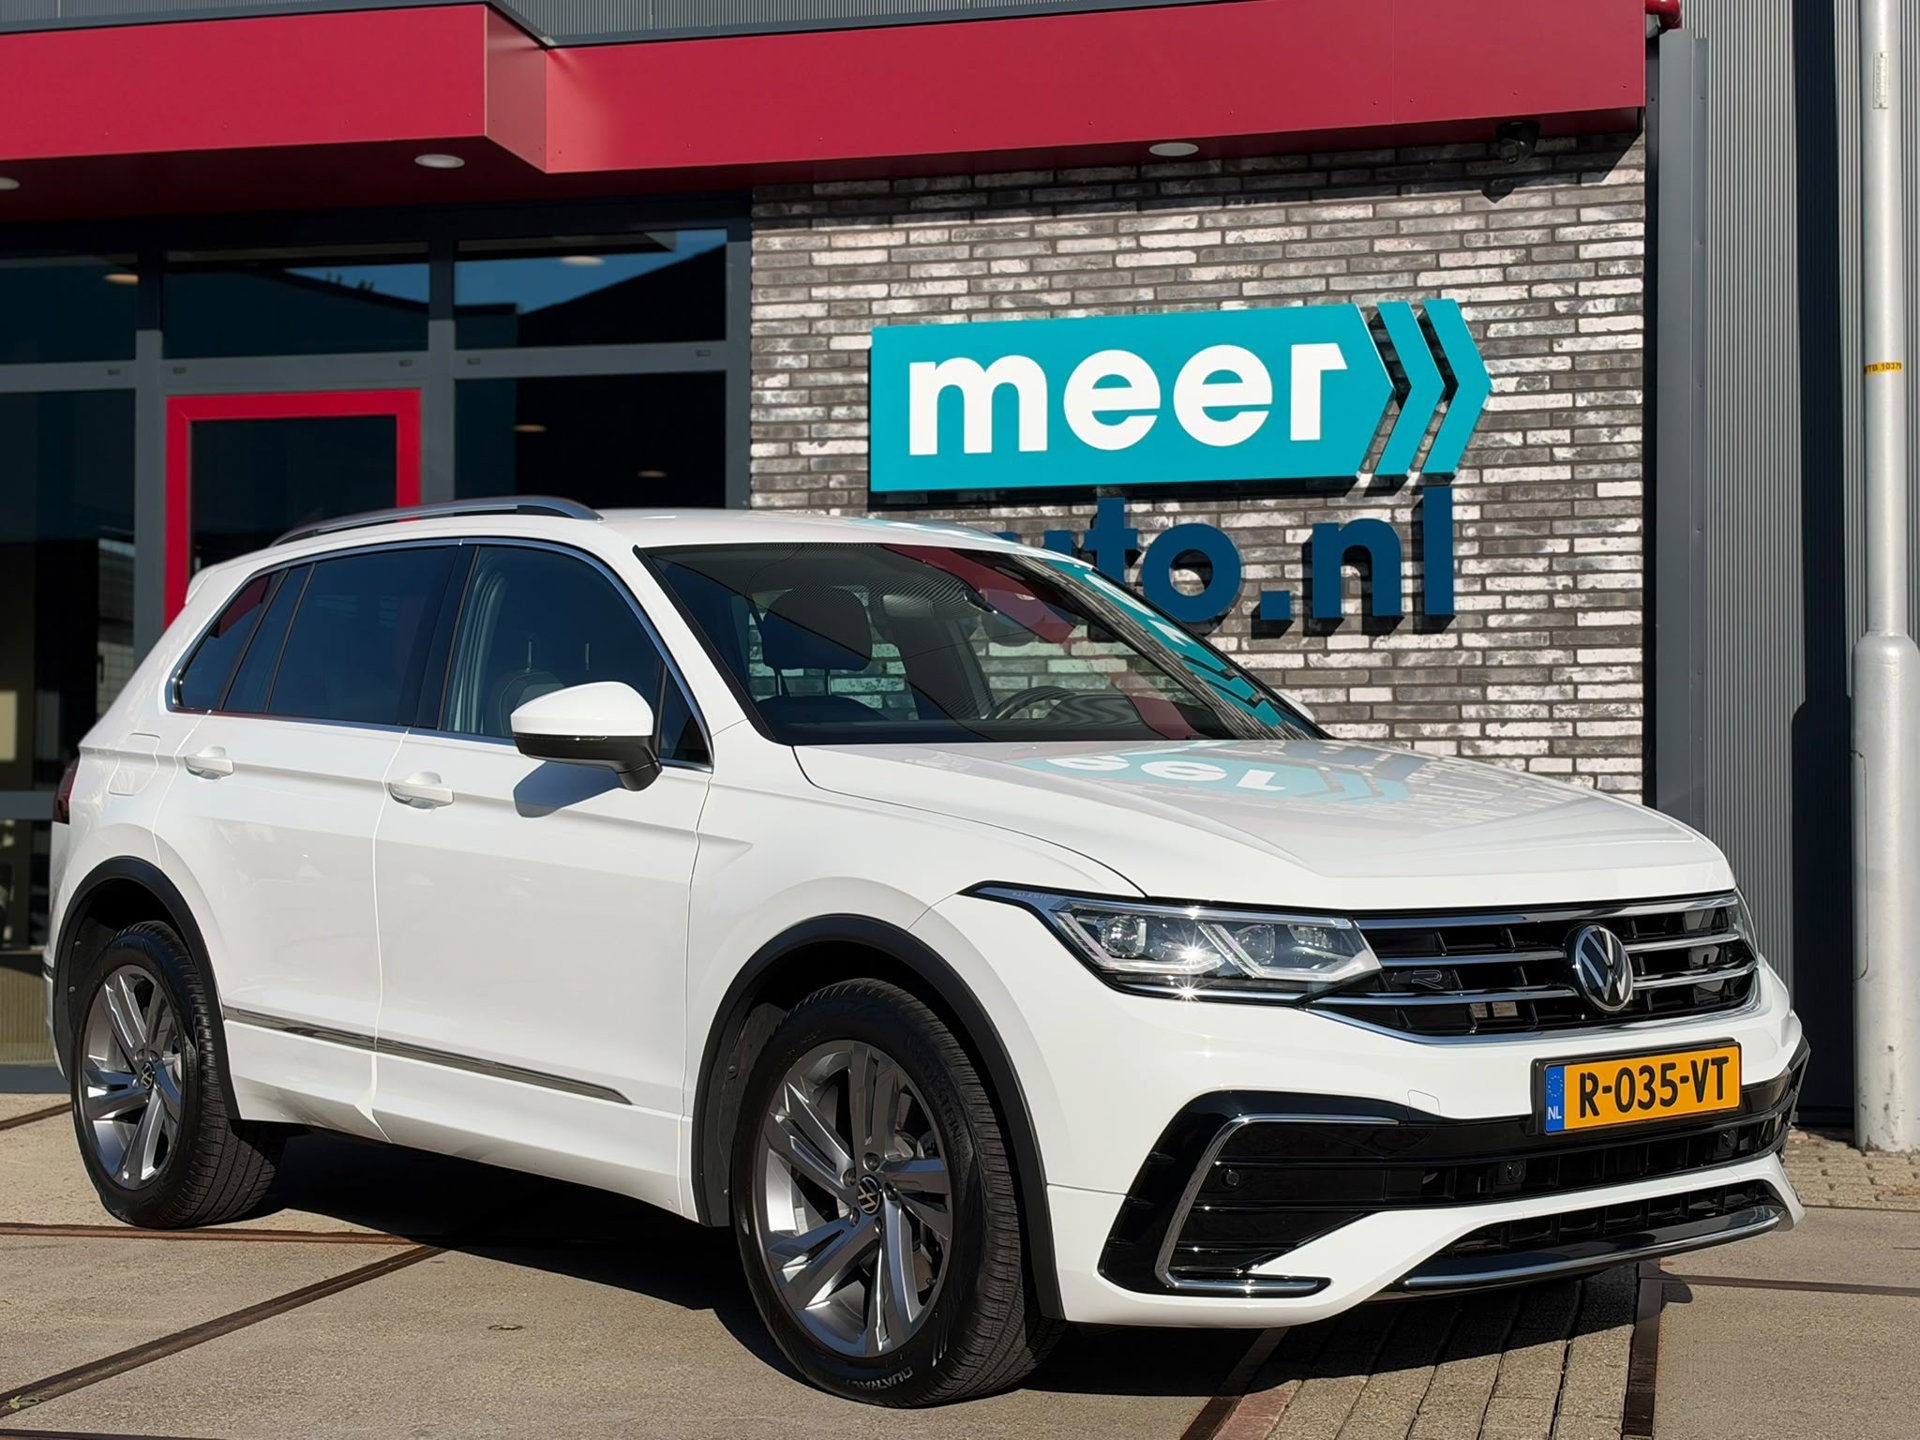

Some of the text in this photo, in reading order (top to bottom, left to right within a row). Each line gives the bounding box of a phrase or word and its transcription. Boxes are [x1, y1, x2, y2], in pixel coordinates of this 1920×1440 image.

[909, 343, 1348, 456] meer
[994, 486, 1452, 619] to.nl
[1547, 1105, 1563, 1121] NL
[1578, 1056, 1730, 1119] R-035-VT
